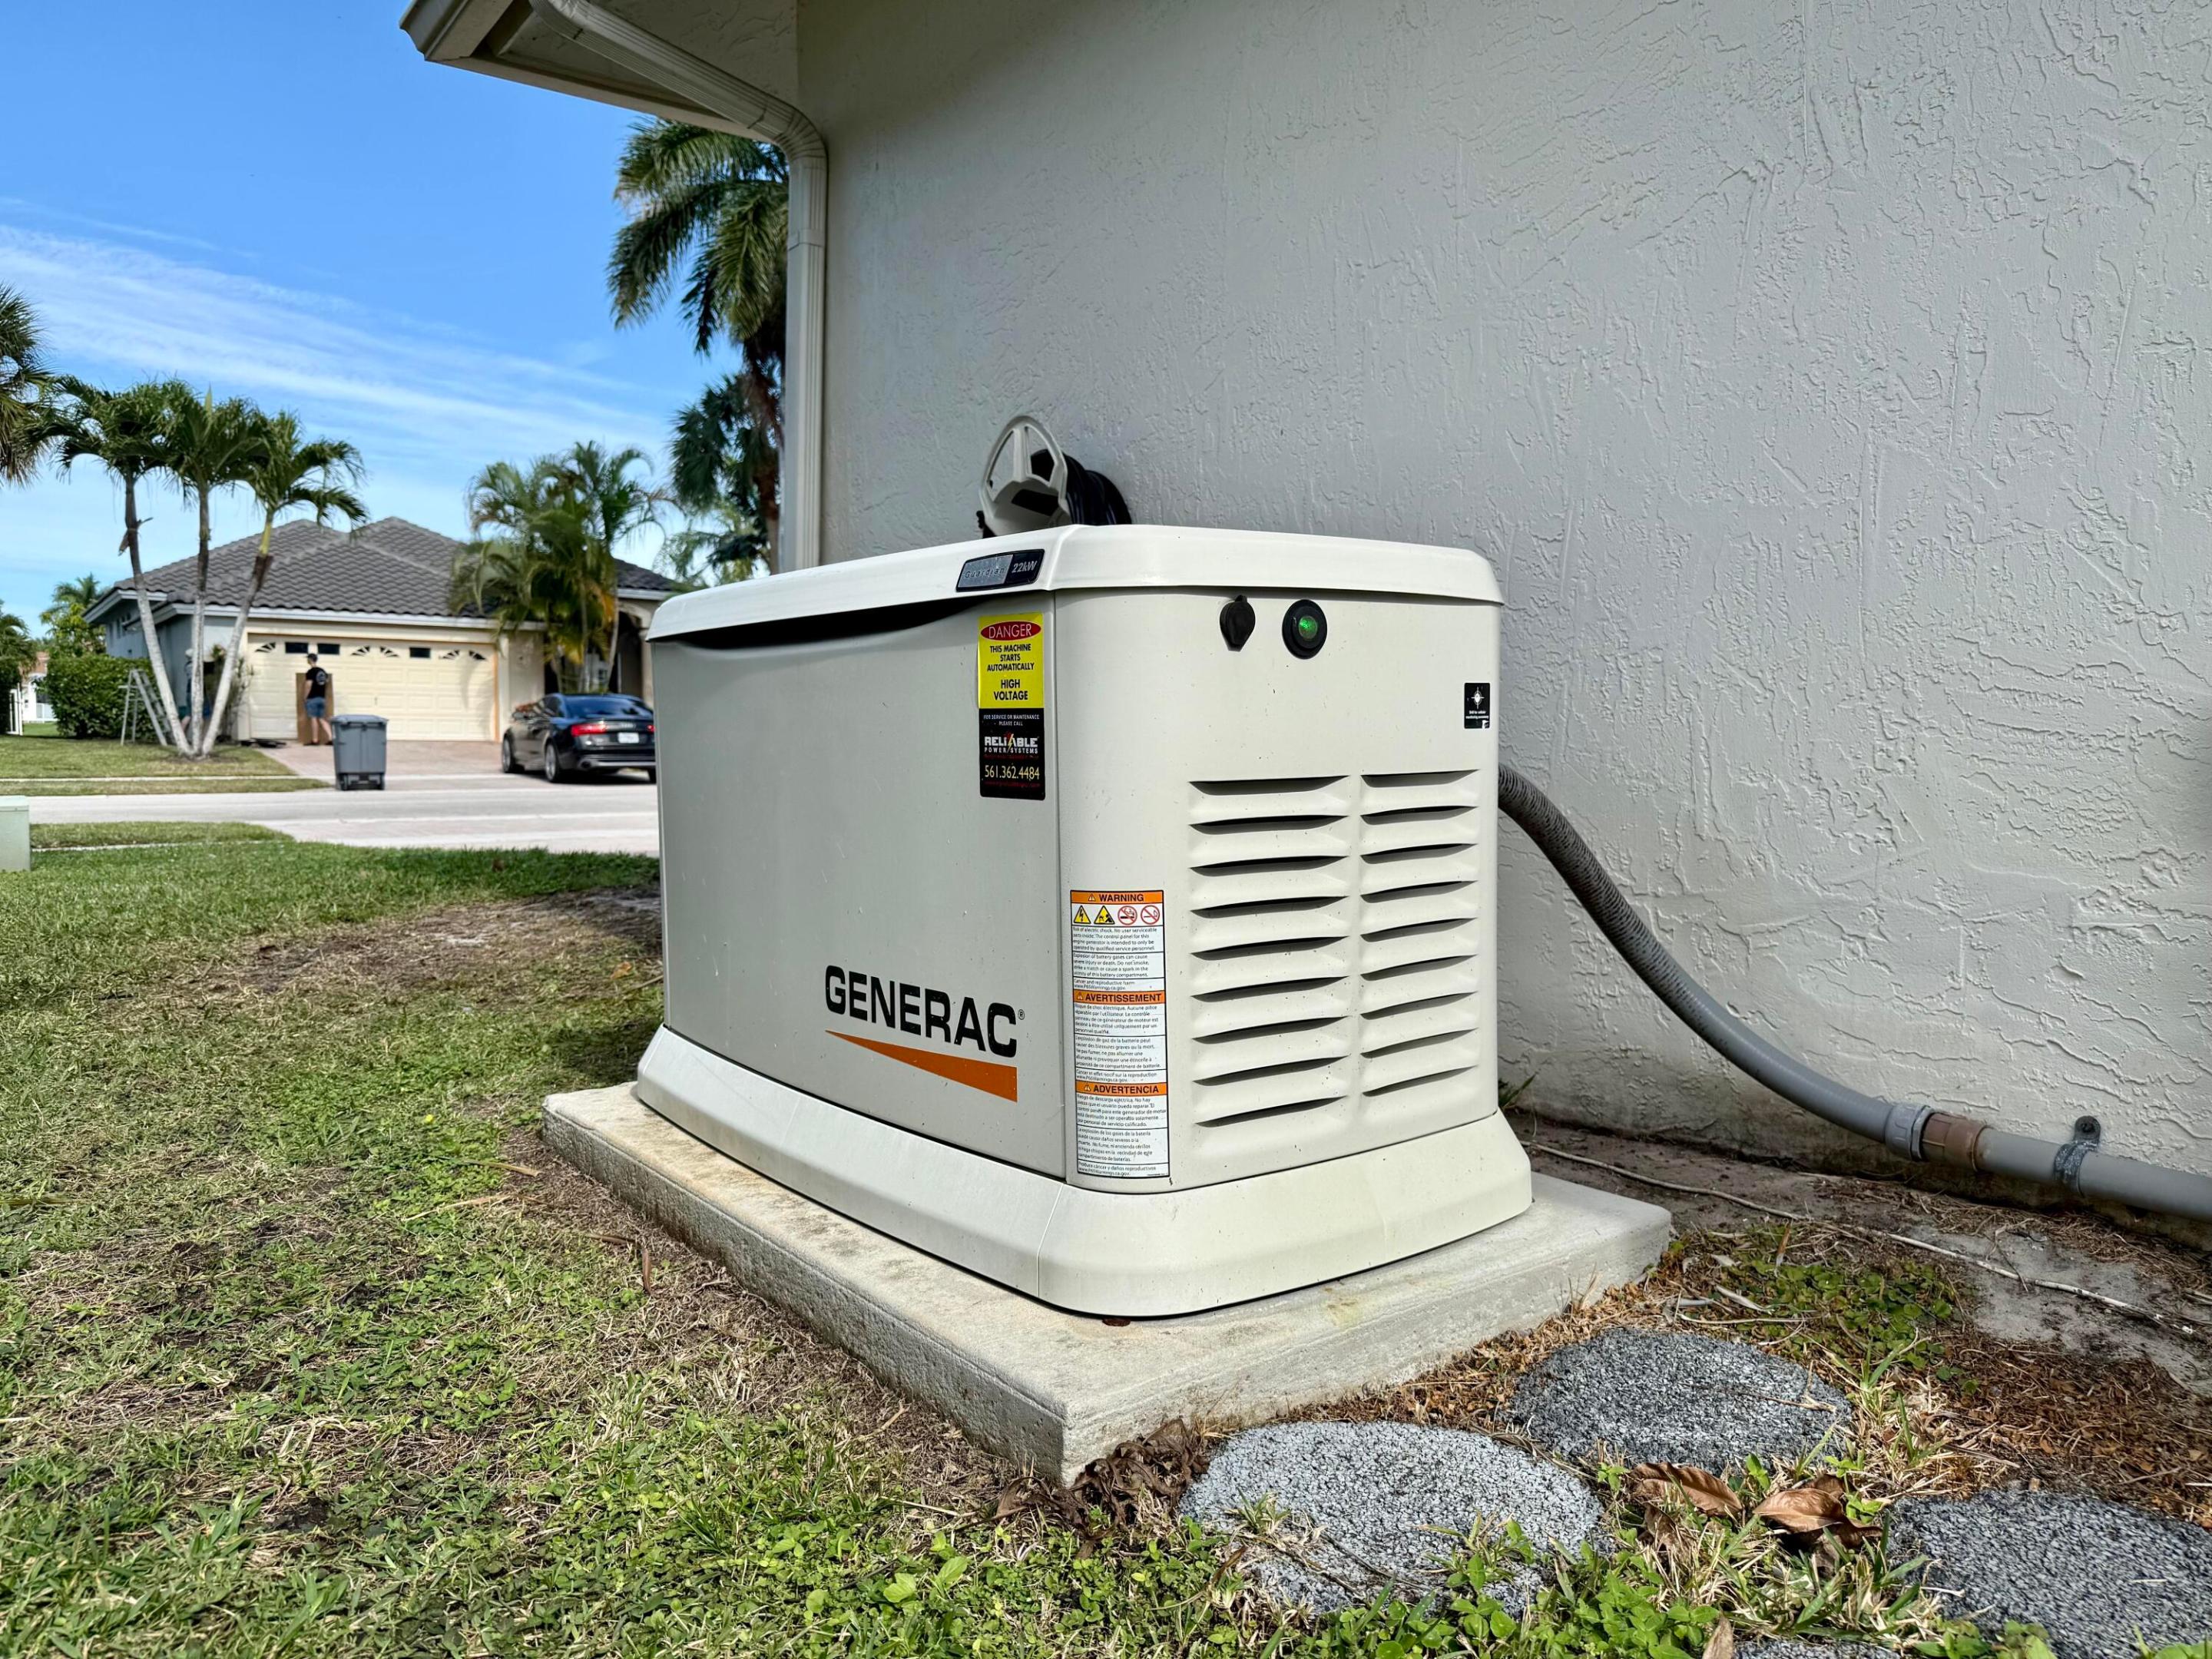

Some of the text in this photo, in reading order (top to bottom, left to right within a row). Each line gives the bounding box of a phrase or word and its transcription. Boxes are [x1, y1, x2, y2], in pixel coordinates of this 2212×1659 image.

[964, 560, 1038, 578] Guardian 22kW
[988, 624, 1032, 639] DANGER
[1004, 644, 1031, 652] MACHINE
[1000, 654, 1021, 662] STARTS
[987, 663, 1035, 671] AUTOMATICALLY
[1001, 679, 1020, 688] HIGH
[994, 690, 1028, 700] VOLTAGE
[985, 735, 1038, 748] RELIABLE
[985, 765, 1040, 780] 561.362.4484
[1085, 993, 1162, 1002] AVERTISSEMENT
[825, 965, 1017, 1058] GENERAC
[1093, 1085, 1159, 1094] ADVERTENCIA
